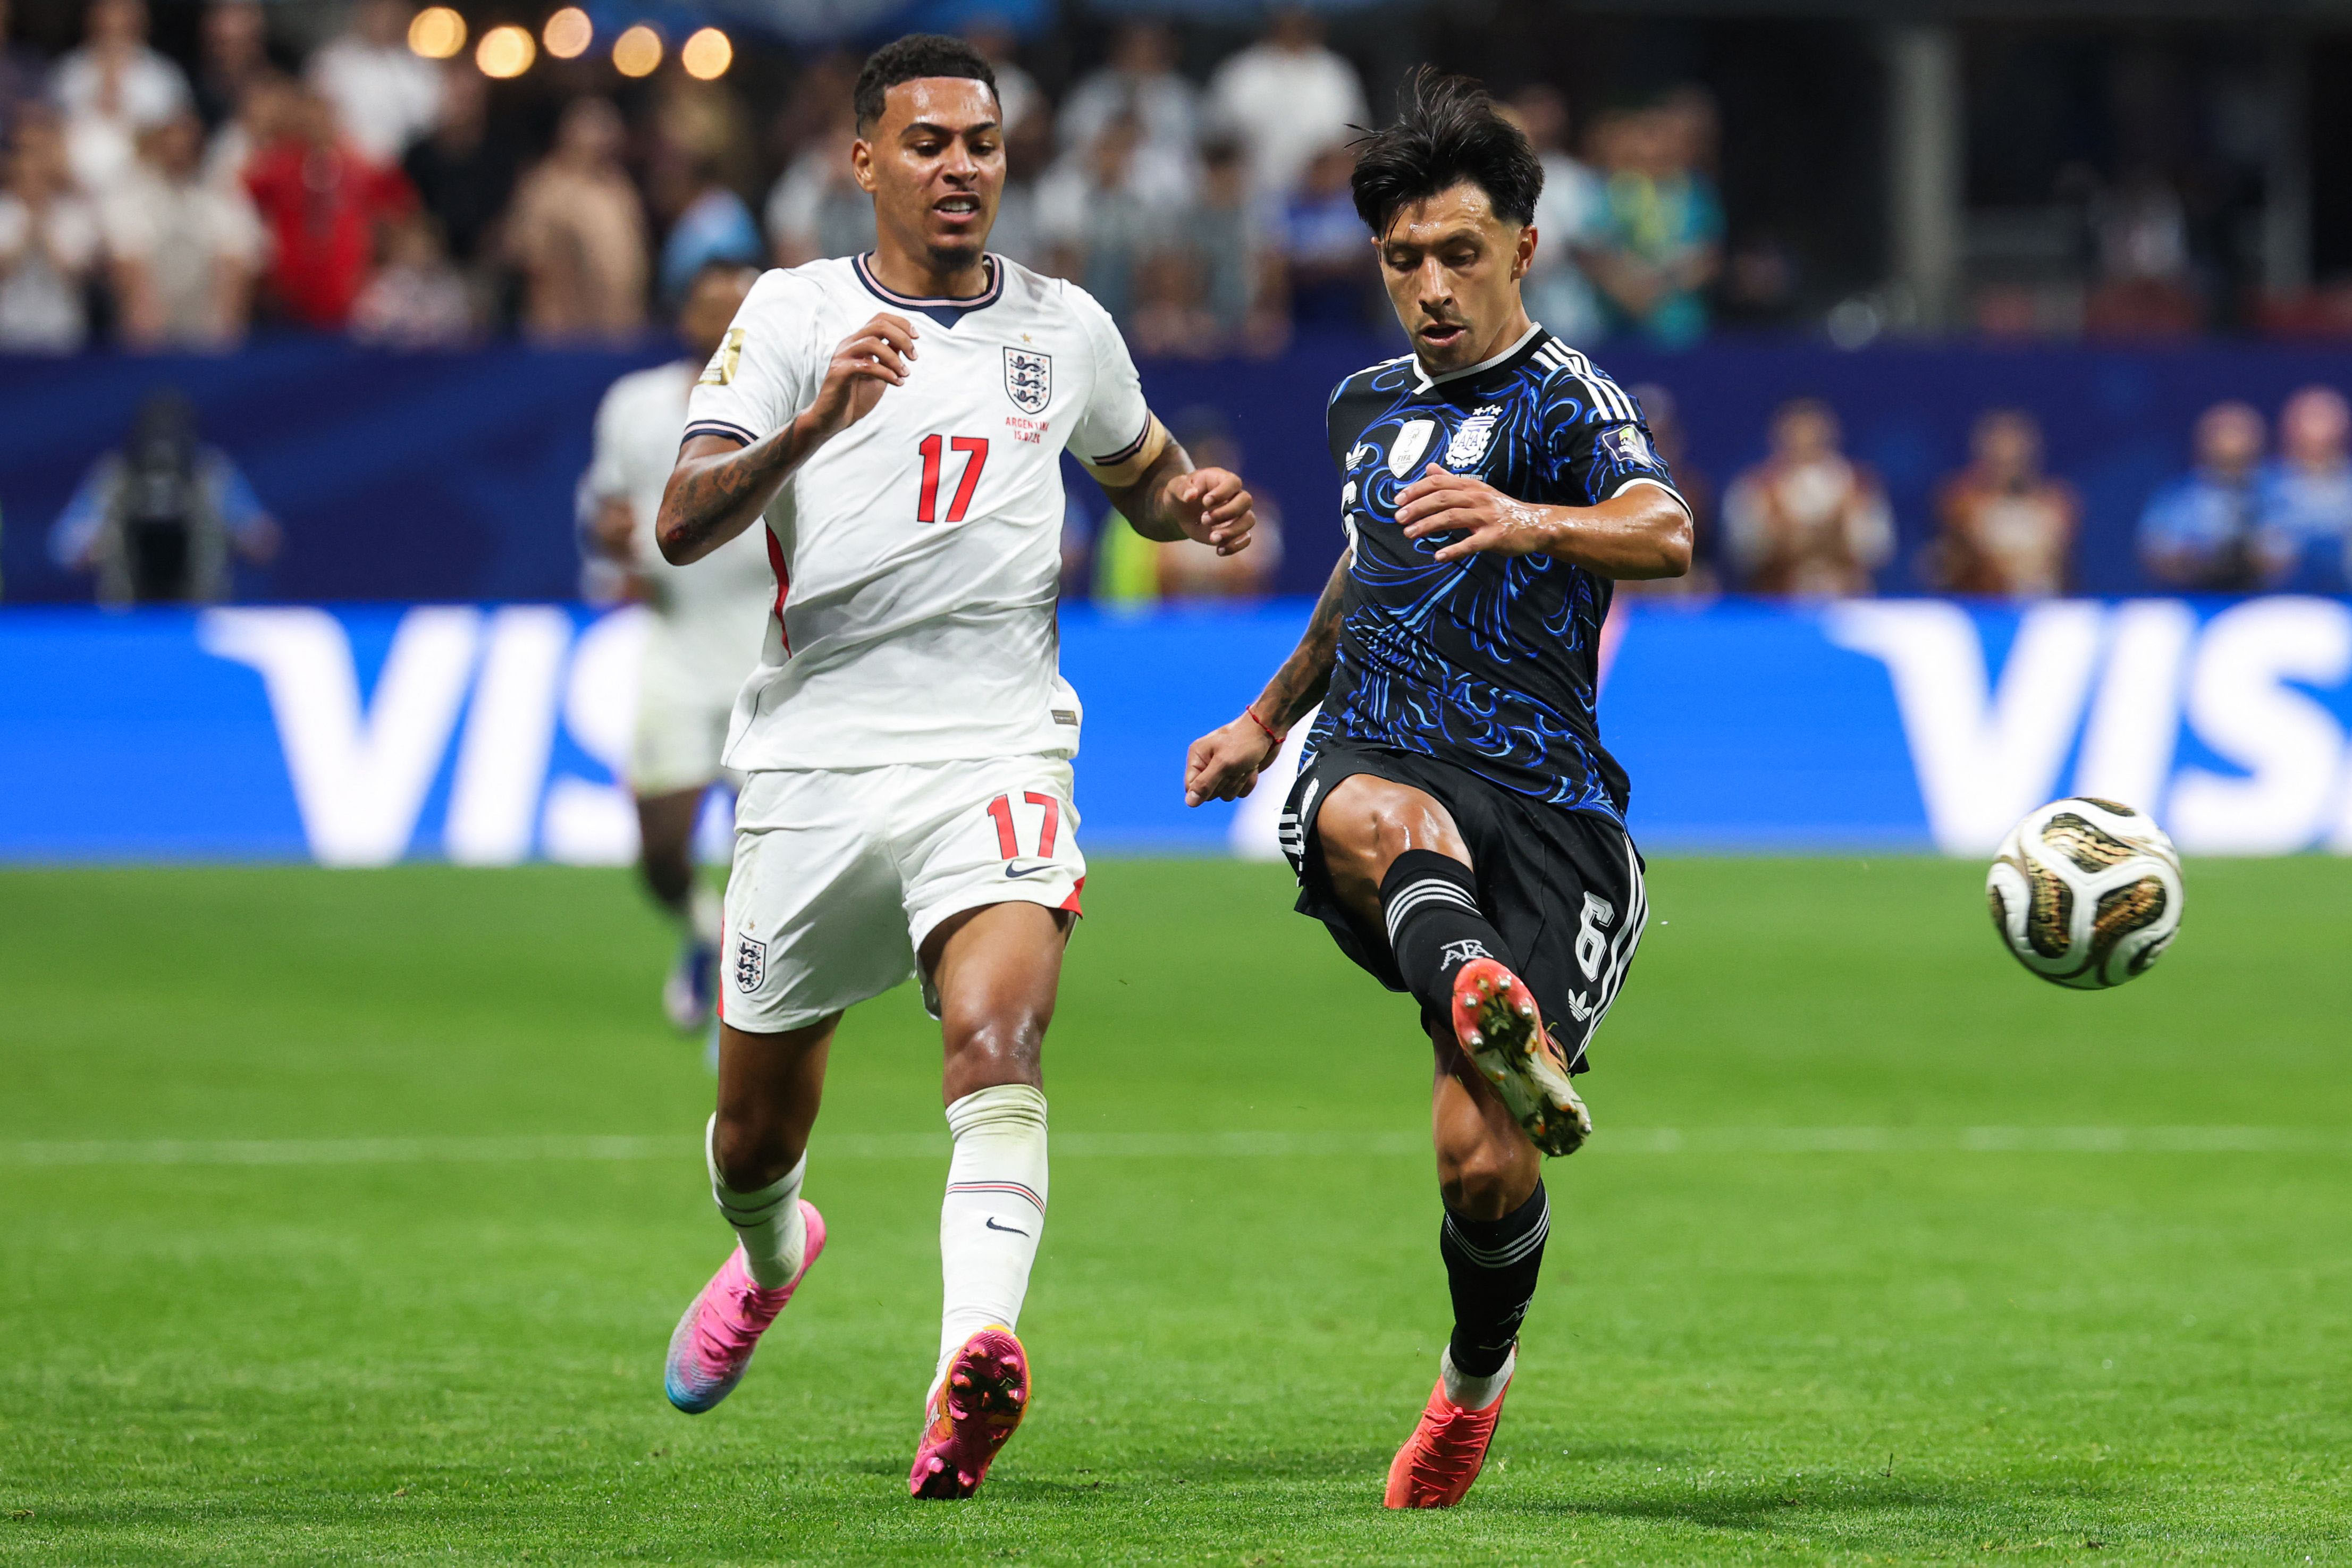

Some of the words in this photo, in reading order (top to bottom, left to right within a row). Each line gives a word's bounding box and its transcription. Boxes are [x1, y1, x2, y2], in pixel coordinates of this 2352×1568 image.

[917, 434, 989, 523] 17
[1457, 428, 1480, 451] AFA
[197, 603, 736, 870] VIS
[1823, 594, 2352, 858] VIS
[987, 791, 1058, 859] 17
[1440, 939, 1494, 971] AFA
[1575, 890, 1614, 982] 6
